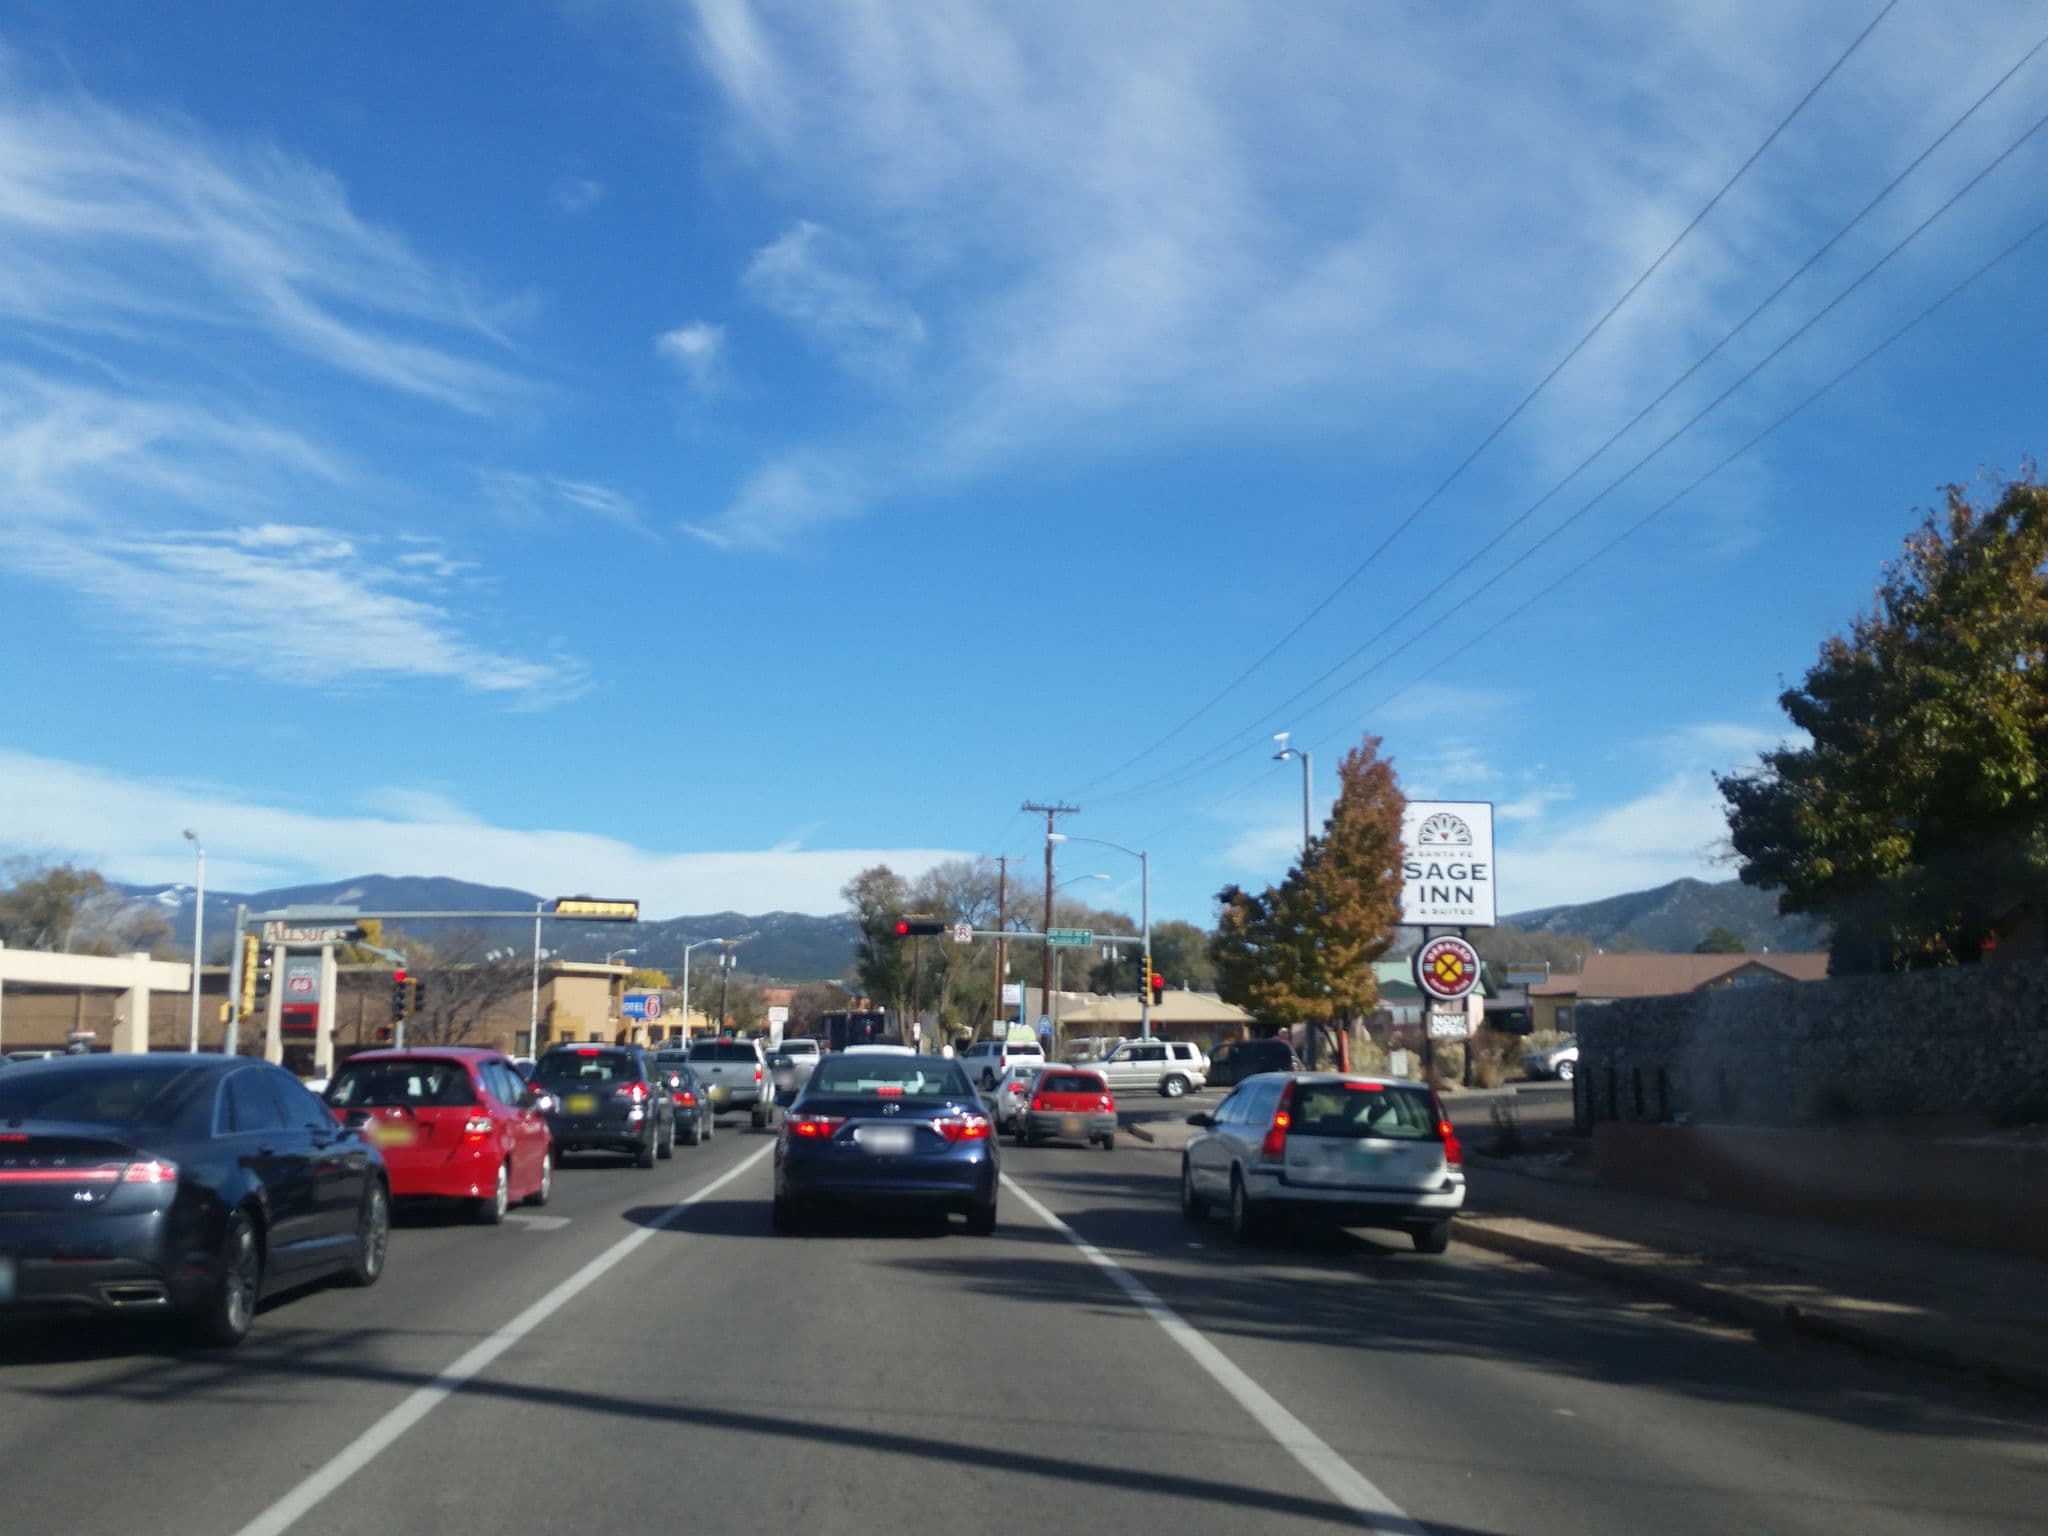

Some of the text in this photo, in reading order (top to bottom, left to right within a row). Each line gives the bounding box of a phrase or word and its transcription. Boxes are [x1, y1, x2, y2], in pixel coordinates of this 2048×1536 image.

[1405, 862, 1487, 881] SAGE
[1420, 886, 1474, 903] INN
[1432, 907, 1475, 915] SUITES
[1427, 943, 1471, 960] DERAILED
[1431, 1014, 1466, 1024] NOW
[1431, 1023, 1468, 1035] OPEN
